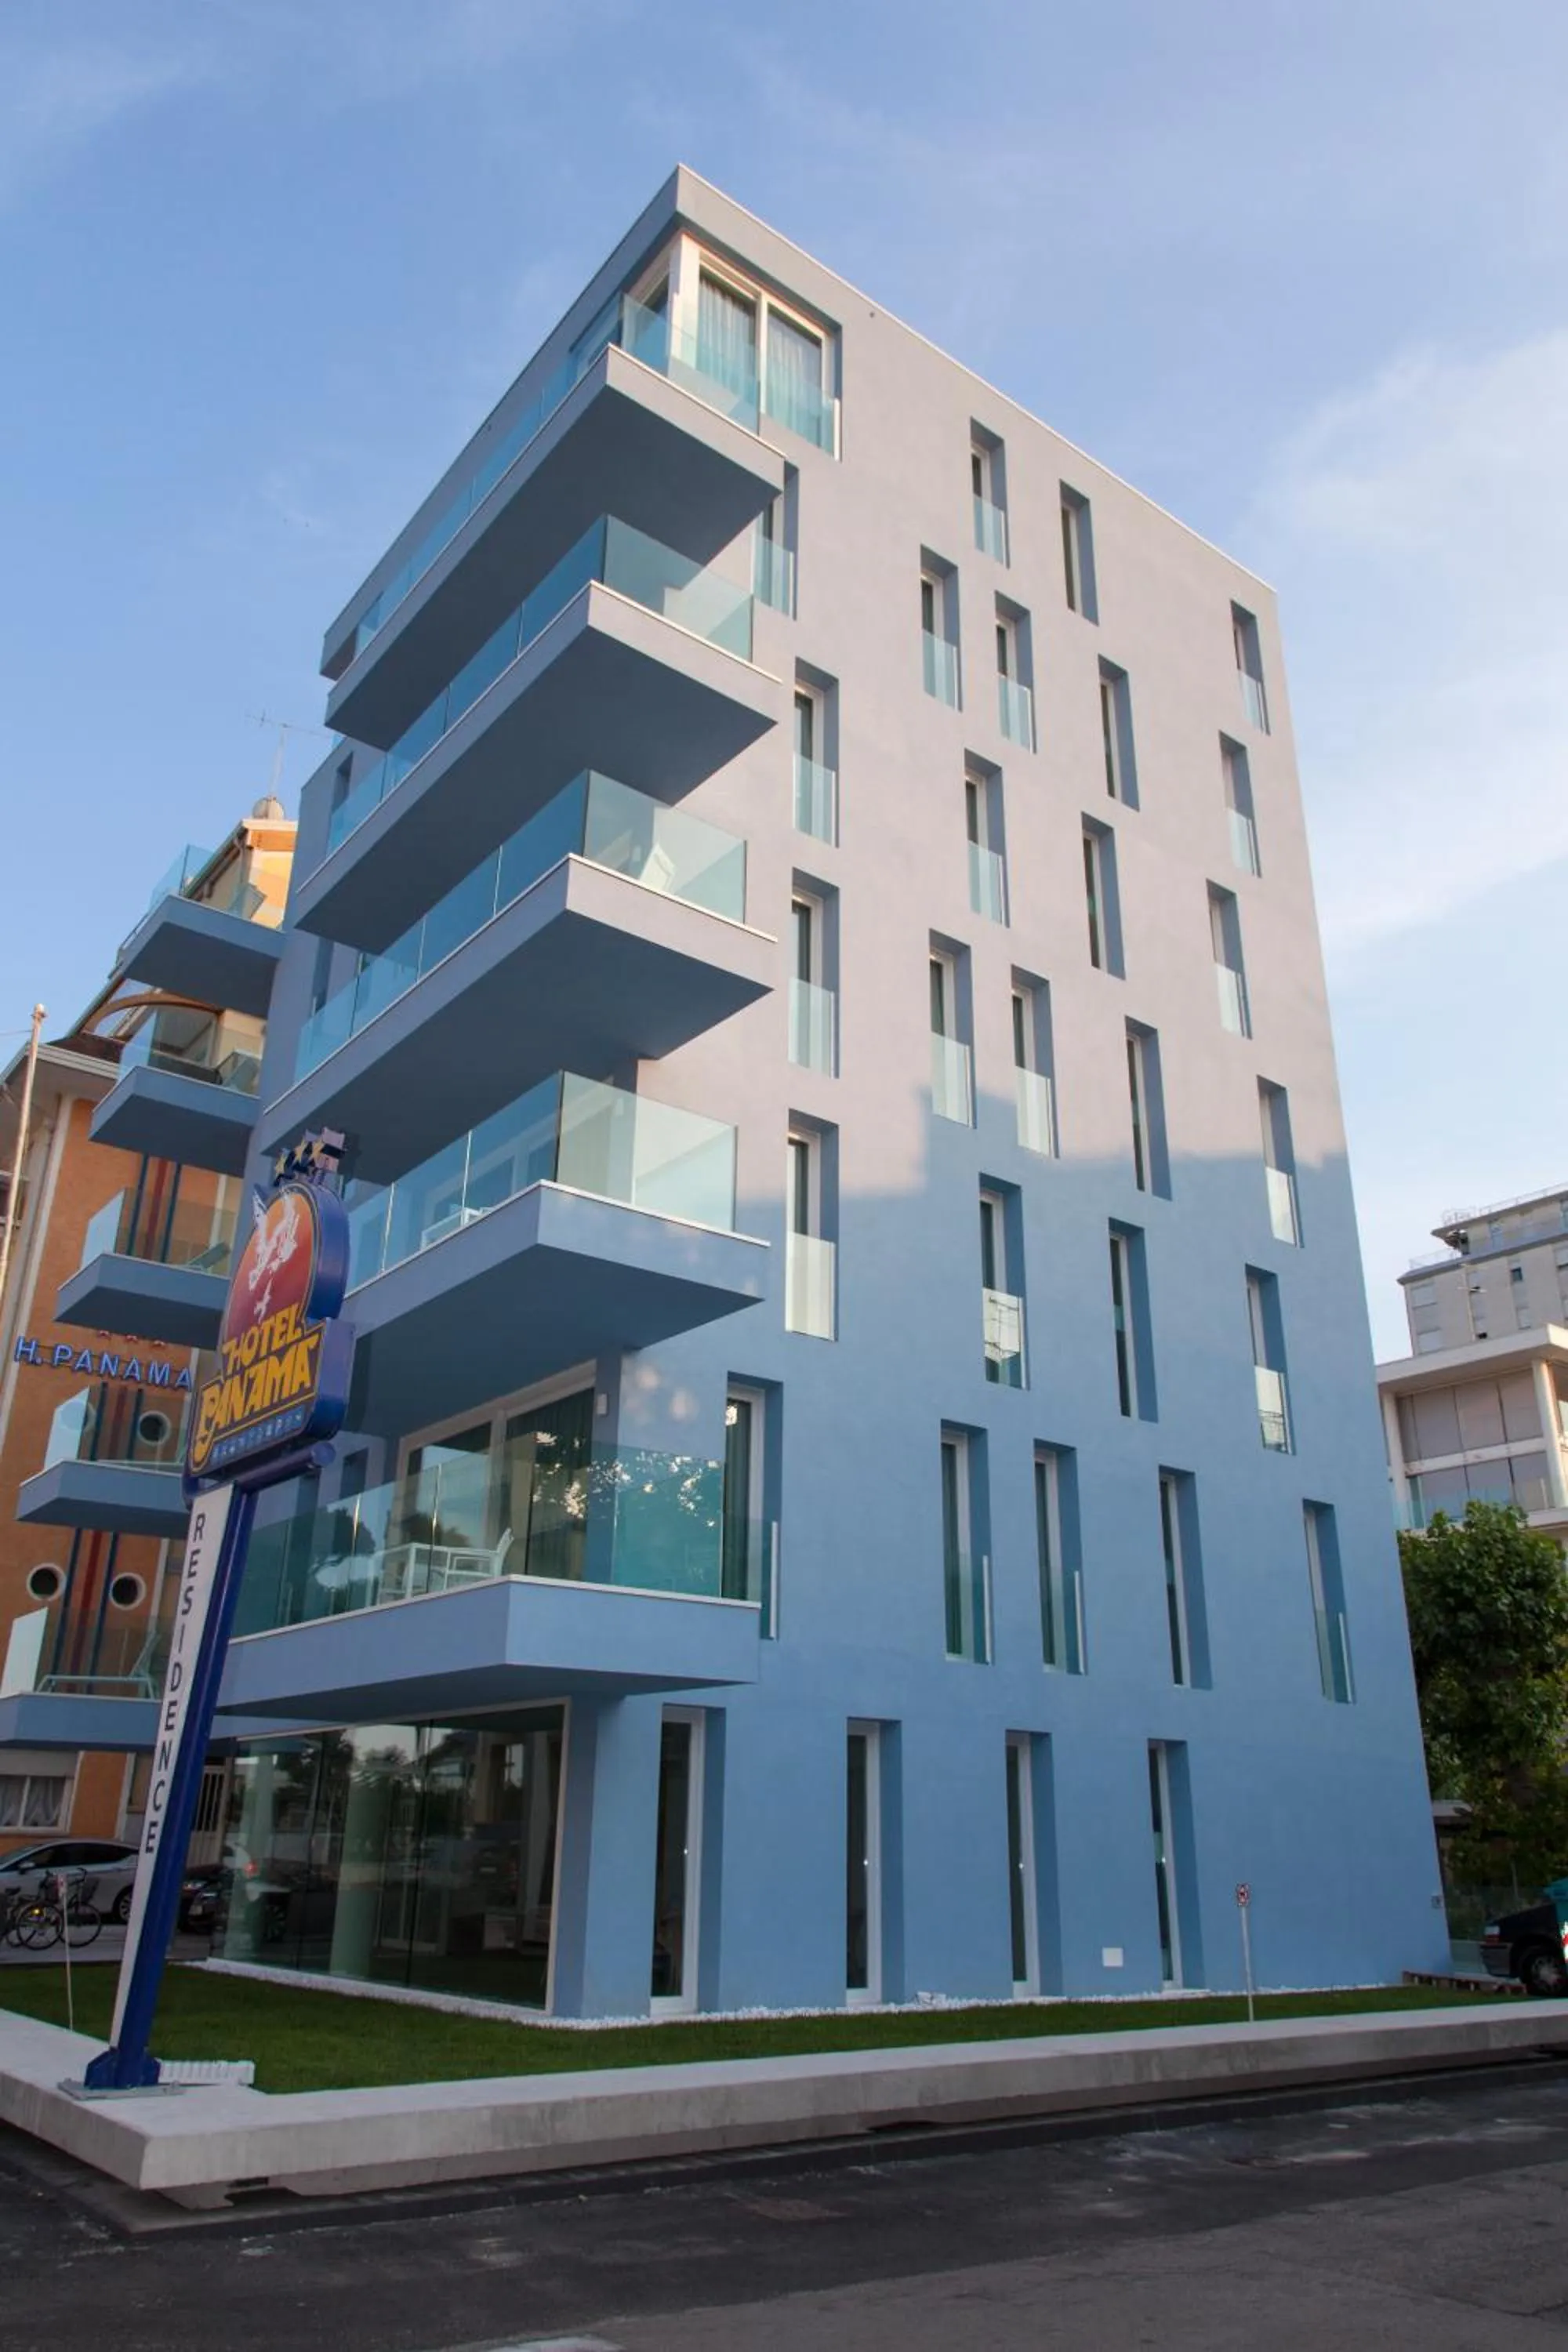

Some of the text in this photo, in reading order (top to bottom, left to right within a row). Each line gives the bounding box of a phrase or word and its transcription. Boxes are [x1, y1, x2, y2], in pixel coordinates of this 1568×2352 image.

[53, 1343, 192, 1391] PANAMA
[223, 1304, 303, 1374] HOTEL
[194, 1333, 320, 1464] PANAMA
[145, 1514, 205, 1853] RESIDENCE
